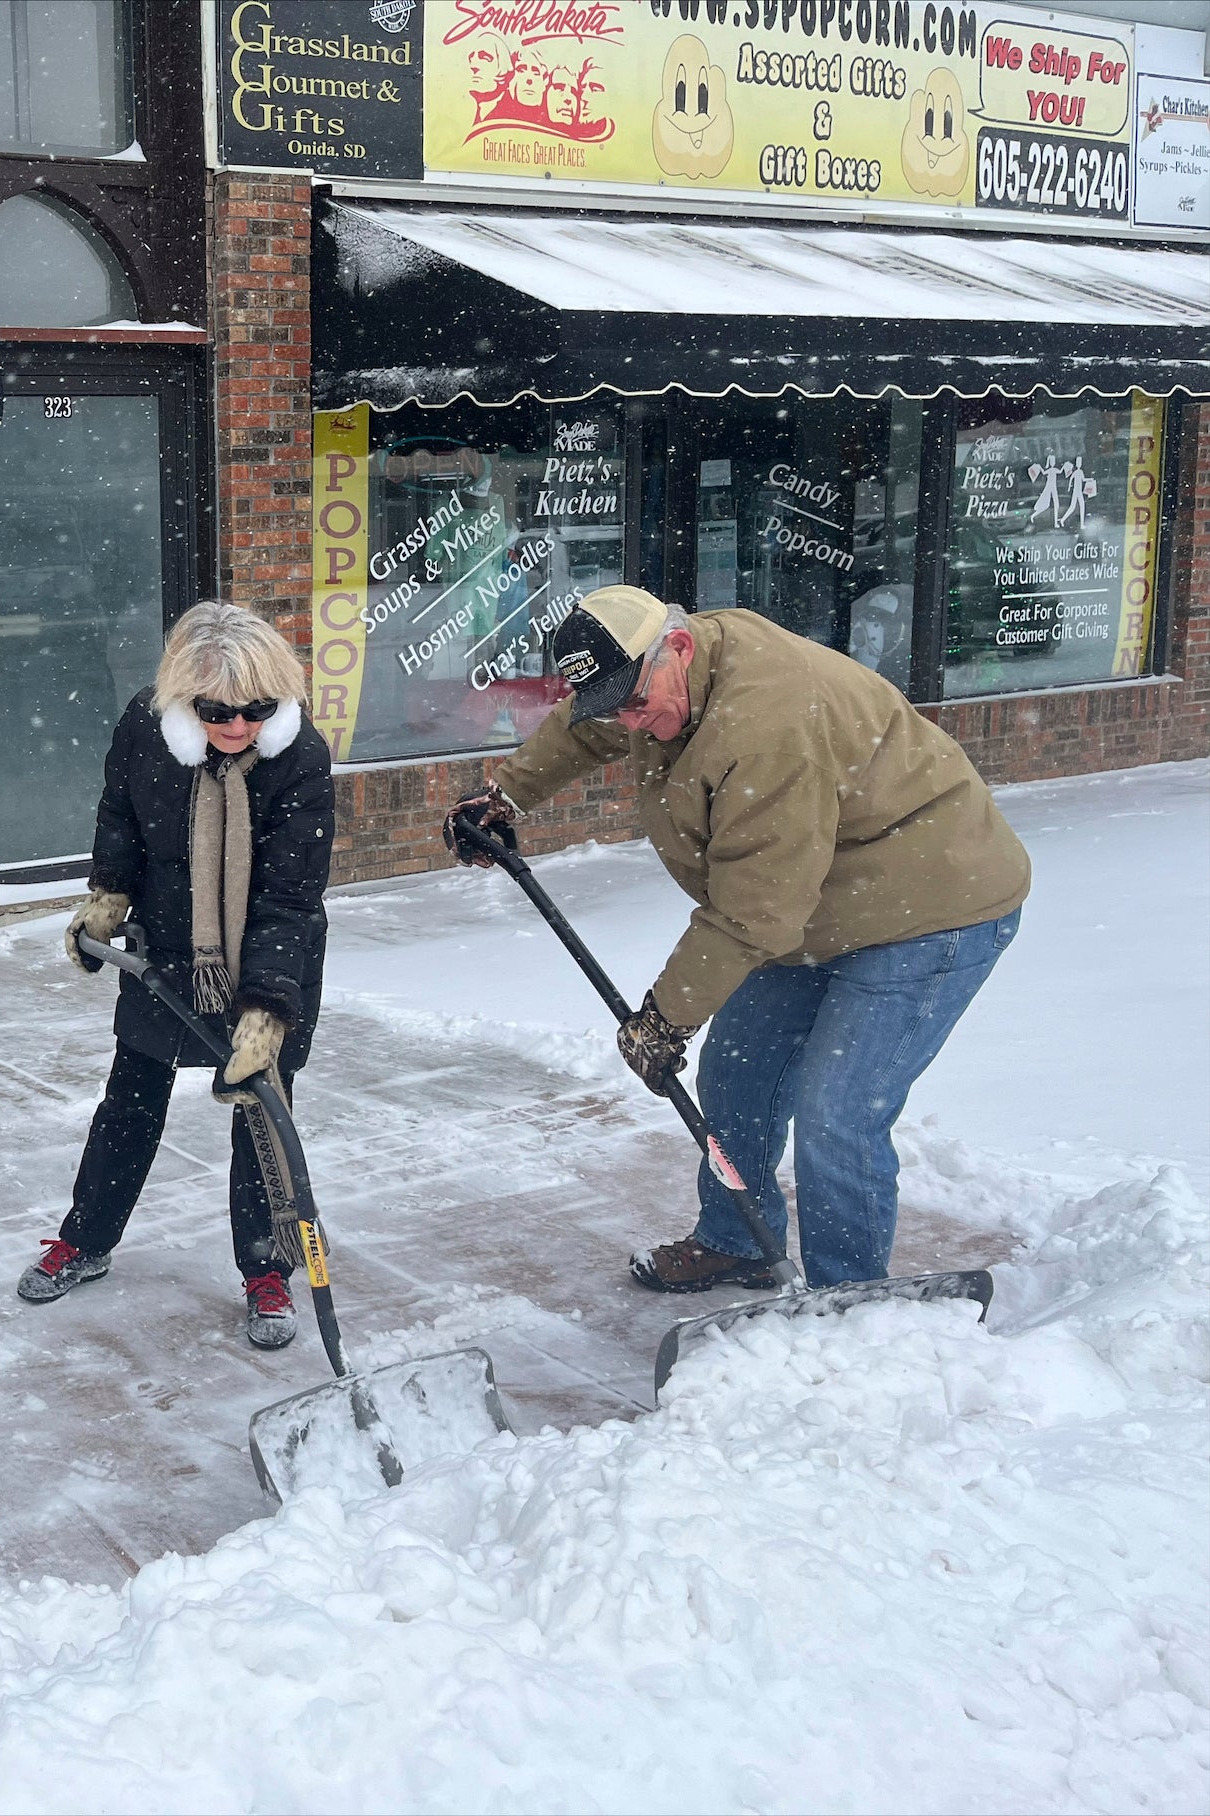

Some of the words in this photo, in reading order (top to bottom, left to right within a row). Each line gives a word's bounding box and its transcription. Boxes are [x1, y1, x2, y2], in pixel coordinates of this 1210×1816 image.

[231, 1, 412, 66] Grassland
[443, 0, 531, 45] South
[525, 0, 624, 45] Dakota
[231, 42, 370, 100] Gourmet
[376, 79, 402, 103] &
[737, 42, 842, 92] Assorted
[850, 56, 906, 100] Gifts
[986, 35, 1023, 70] We
[1028, 42, 1081, 85] Ship
[1086, 51, 1126, 85] For
[232, 82, 345, 136] Gifts
[813, 100, 832, 140] &
[1027, 90, 1086, 127] YOU!
[1162, 95, 1184, 115] Char's
[1184, 97, 1209, 117] Kitchen
[343, 143, 367, 159] SD
[483, 137, 506, 162] GREAT
[508, 140, 530, 164] FACES
[533, 141, 556, 165] GREAT
[760, 144, 807, 187] Gift
[815, 149, 881, 192] Boxes
[1139, 157, 1168, 174] Syrups
[1161, 141, 1182, 155] Jams
[1190, 144, 1210, 158] Jellie
[978, 137, 1127, 212] 605-222-6240
[44, 396, 72, 418] 323
[541, 456, 613, 485] Pietz's
[768, 463, 842, 509] Candy
[960, 465, 1016, 491] Pietz's
[533, 488, 618, 517] Kuchen
[964, 494, 1009, 519] Pizza
[369, 489, 465, 581] Grassland
[762, 516, 855, 572] Popcorn
[995, 546, 1015, 564] We
[1017, 545, 1041, 565] Ship
[1045, 544, 1071, 561] Your
[1073, 542, 1099, 560] Gifts
[1101, 541, 1120, 558] For
[1116, 435, 1156, 676] POPCORN
[359, 573, 421, 635] Soups
[424, 557, 443, 583] &
[440, 504, 501, 563] Mixes
[993, 568, 1015, 586] You
[1019, 565, 1056, 585] United
[1059, 565, 1089, 582] States
[1093, 562, 1119, 579] Wide
[315, 453, 362, 761] POPCORN
[398, 601, 475, 676] Hosmer
[475, 532, 556, 609] Noodles
[999, 605, 1031, 624] Great
[1034, 603, 1053, 621] For
[470, 636, 530, 692] Char's
[528, 585, 585, 646] Jellies
[995, 627, 1049, 645] Customer
[1051, 623, 1072, 641] Gift
[1075, 621, 1109, 640] Giving
[306, 1226, 326, 1285] STEELCORE
